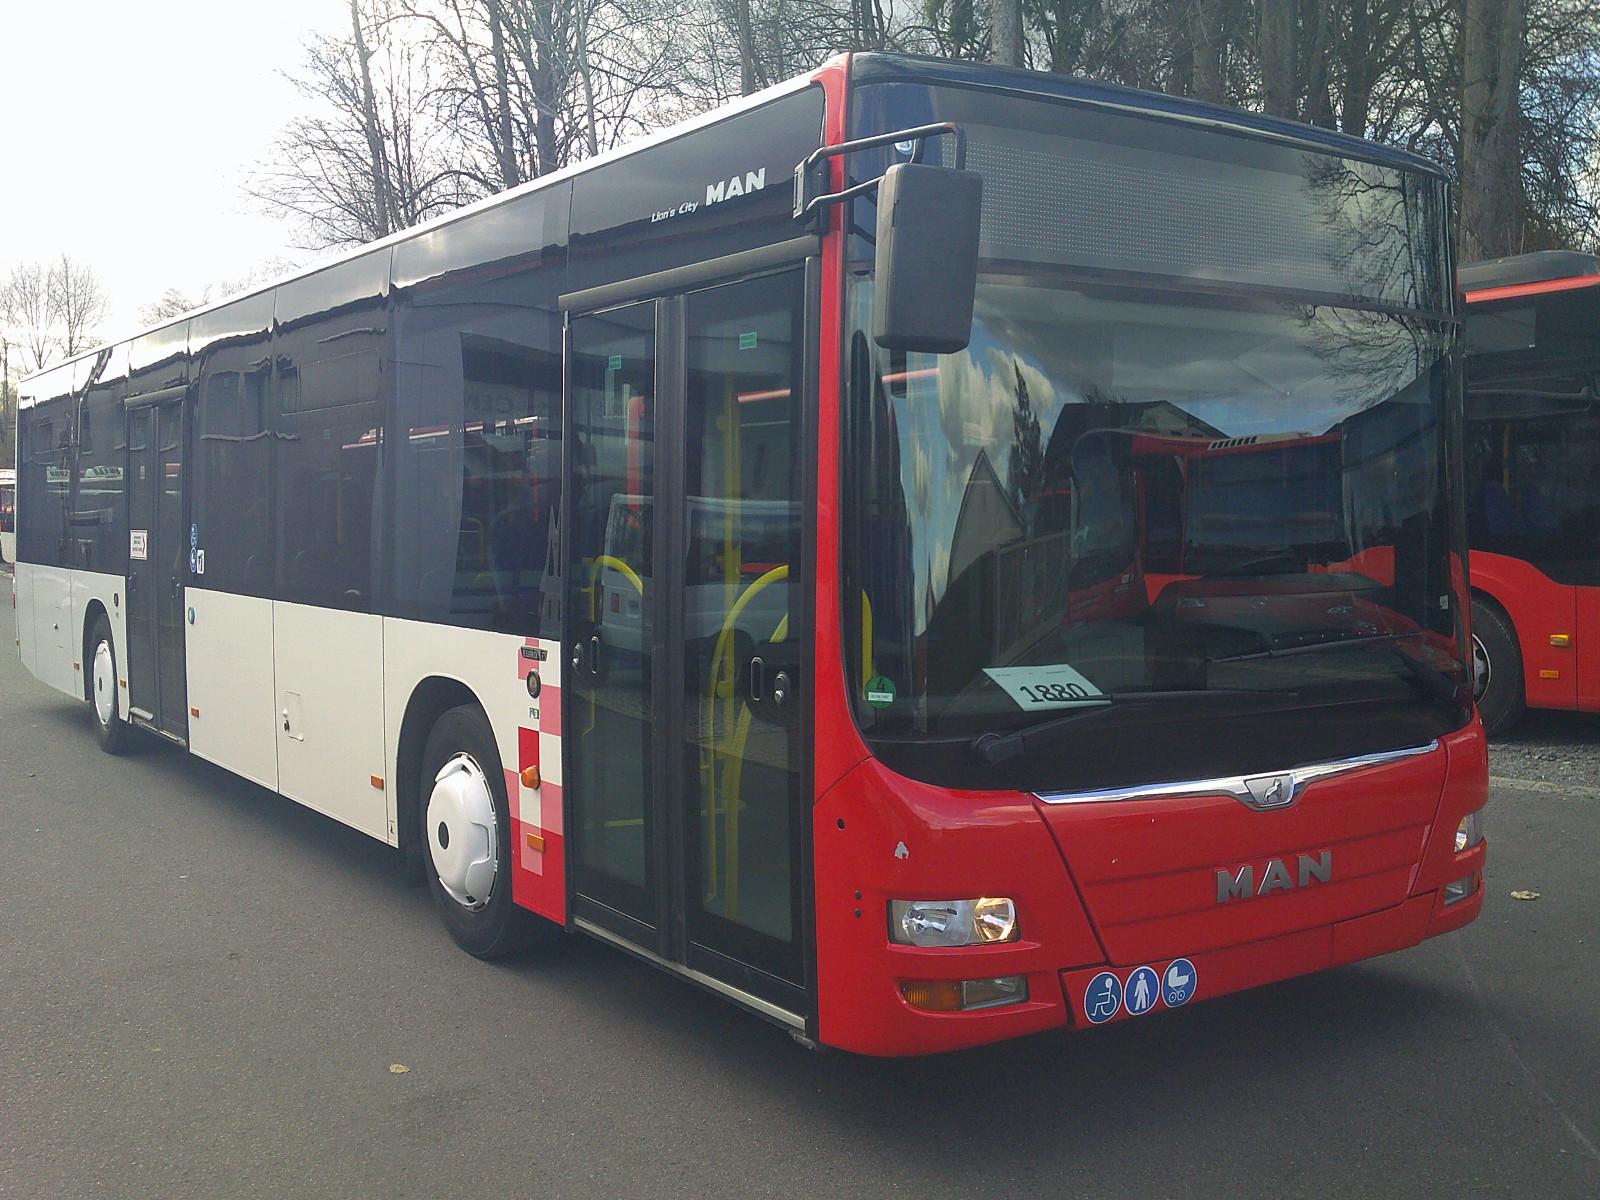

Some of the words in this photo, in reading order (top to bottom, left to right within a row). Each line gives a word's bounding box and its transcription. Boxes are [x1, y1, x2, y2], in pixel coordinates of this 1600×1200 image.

[705, 167, 766, 206] MAN
[651, 207, 676, 223] Lion's
[678, 201, 699, 215] City
[876, 677, 887, 693] 4
[1019, 682, 1089, 703] 1880
[1215, 849, 1333, 904] MAN
